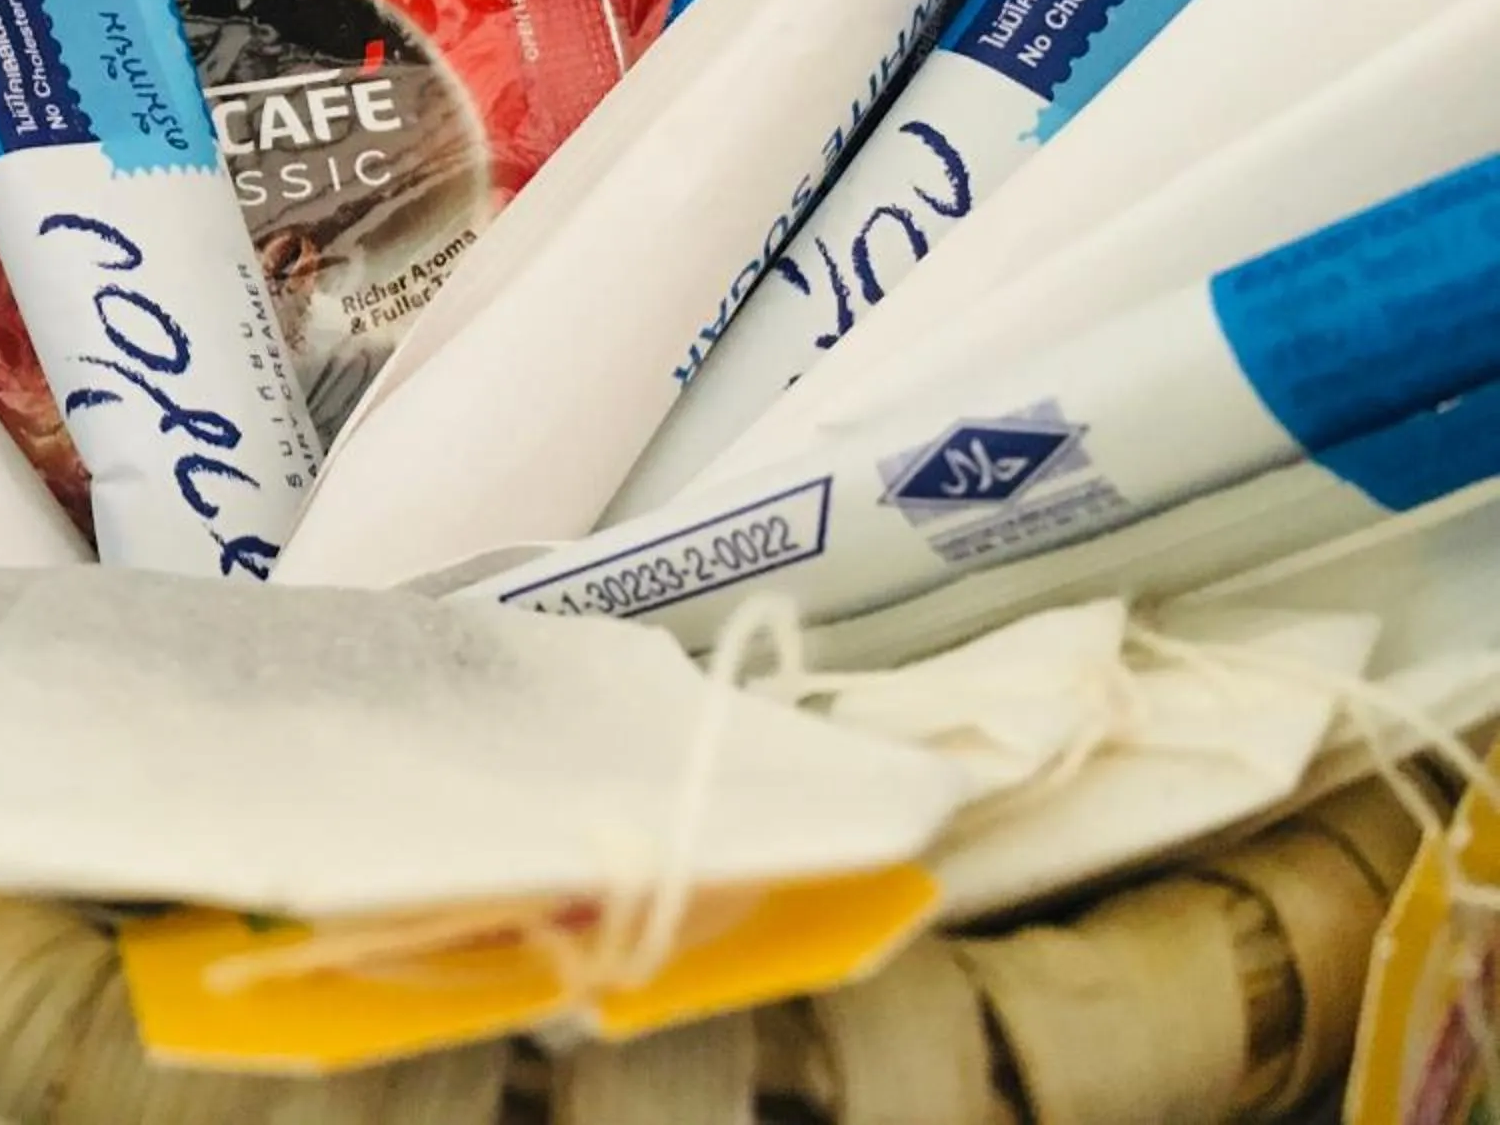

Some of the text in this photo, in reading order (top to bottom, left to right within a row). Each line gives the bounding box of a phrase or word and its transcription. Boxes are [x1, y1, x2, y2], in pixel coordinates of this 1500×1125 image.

[1016, 31, 1054, 68] No
[42, 102, 68, 130] No
[236, 149, 393, 207] SSIC
[339, 273, 411, 316] Richer
[409, 226, 478, 285] Aroma
[235, 260, 293, 401] CREAMER
[346, 288, 434, 336] & Fuller
